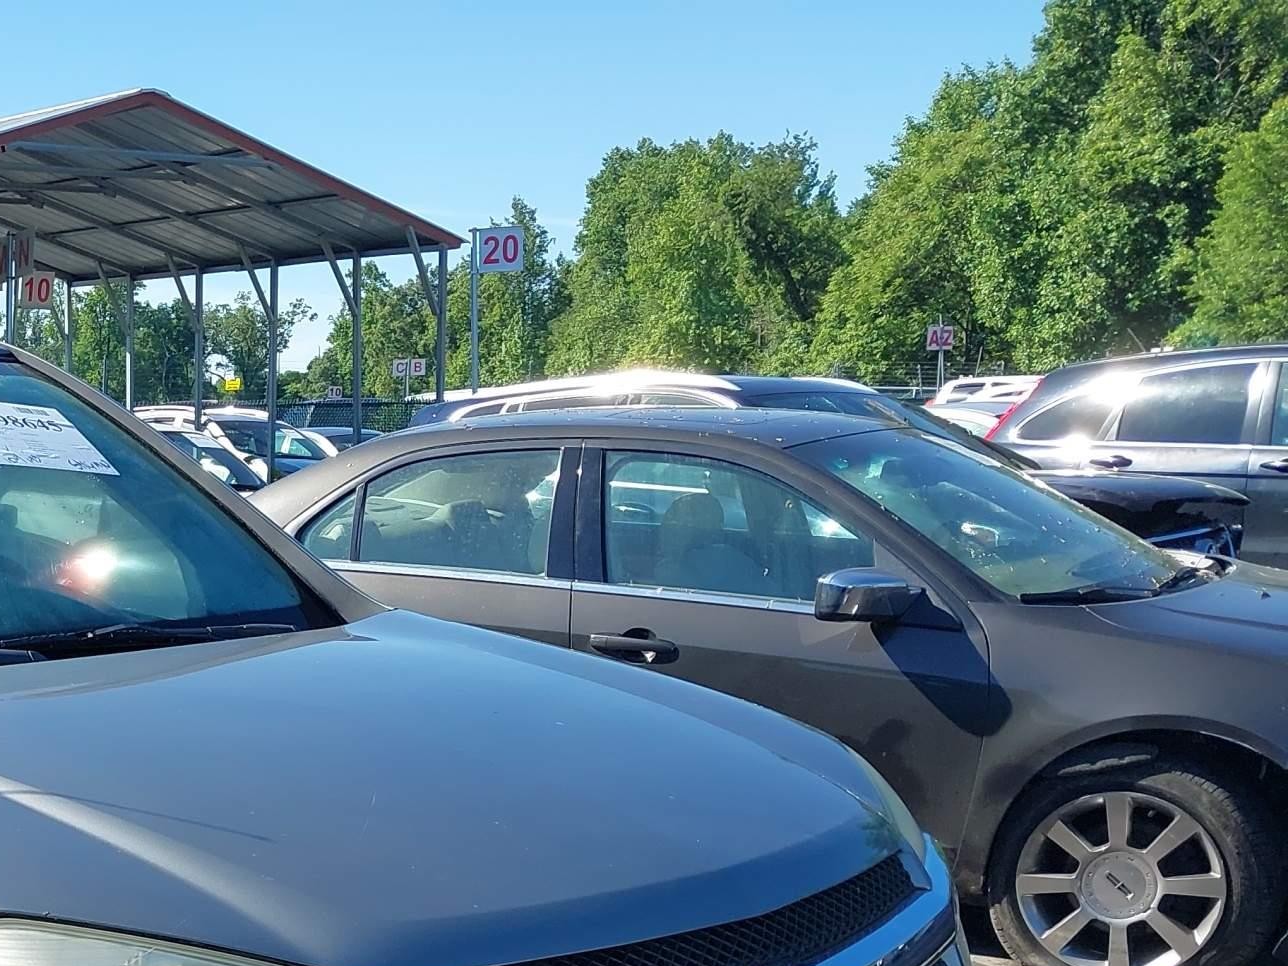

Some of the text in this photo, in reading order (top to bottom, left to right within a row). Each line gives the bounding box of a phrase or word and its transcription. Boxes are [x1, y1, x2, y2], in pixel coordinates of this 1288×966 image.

[19, 236, 30, 268] N
[483, 234, 519, 264] 20
[24, 277, 50, 302] 10
[414, 361, 423, 373] B
[328, 386, 342, 398] 10
